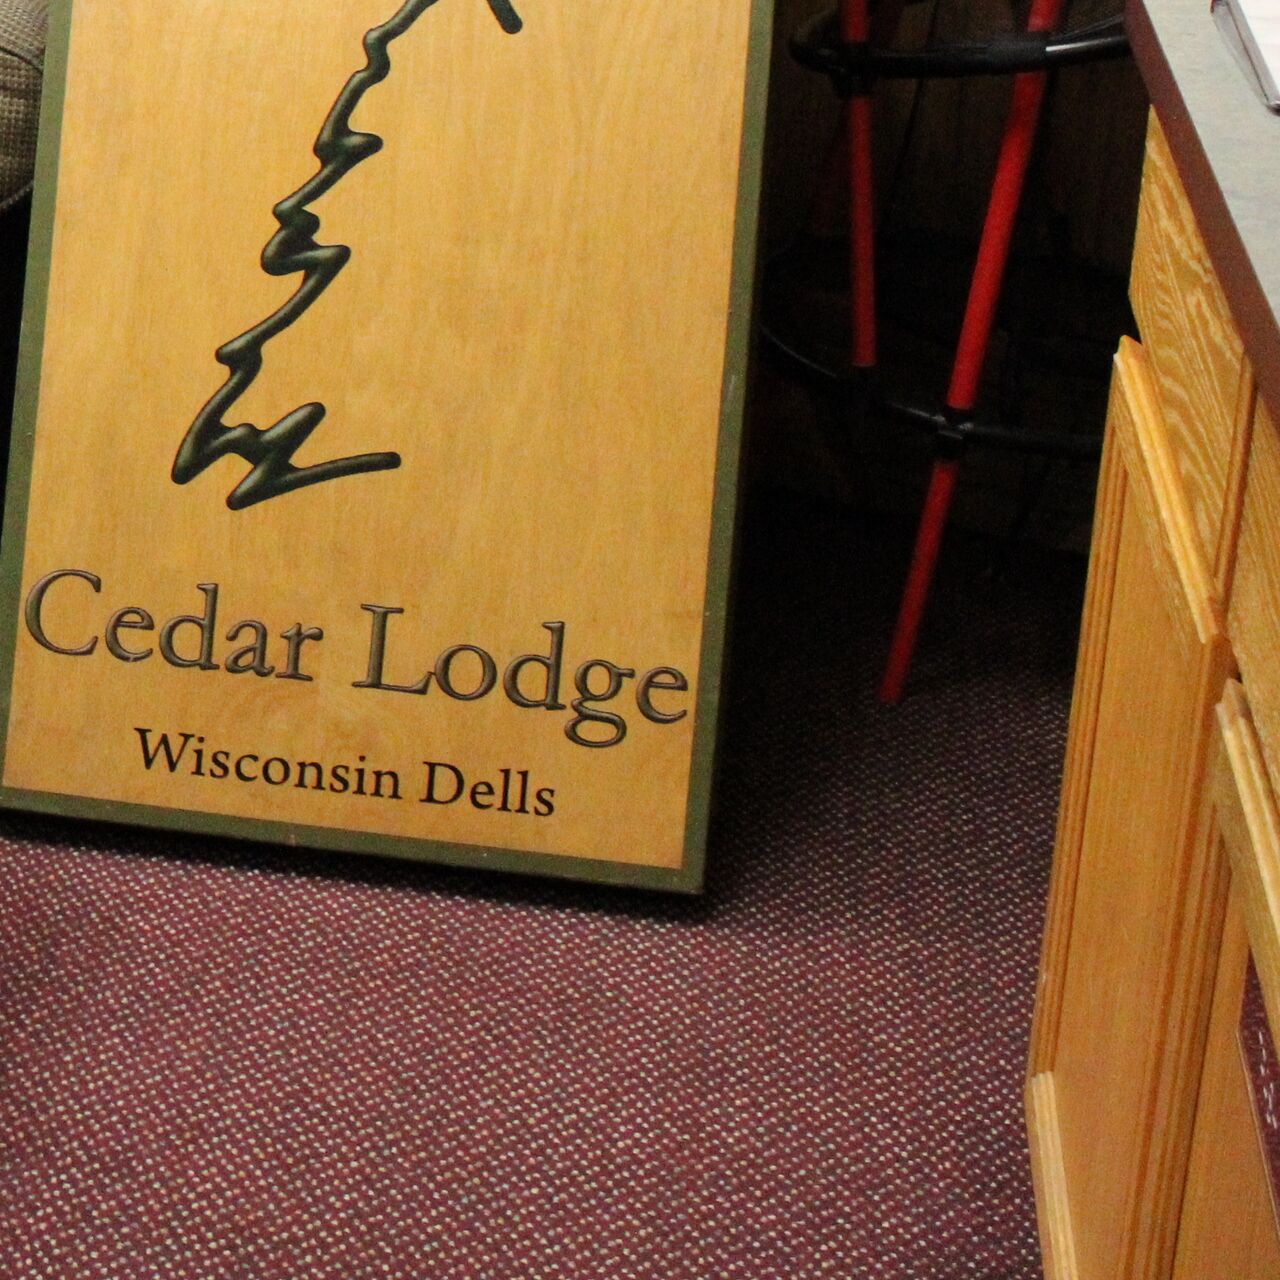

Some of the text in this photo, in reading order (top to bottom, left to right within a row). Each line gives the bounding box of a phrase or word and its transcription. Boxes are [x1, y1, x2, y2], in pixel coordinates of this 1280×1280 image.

[24, 568, 689, 749] Cedar Lodge
[133, 725, 557, 818] Wisconsin Dells
